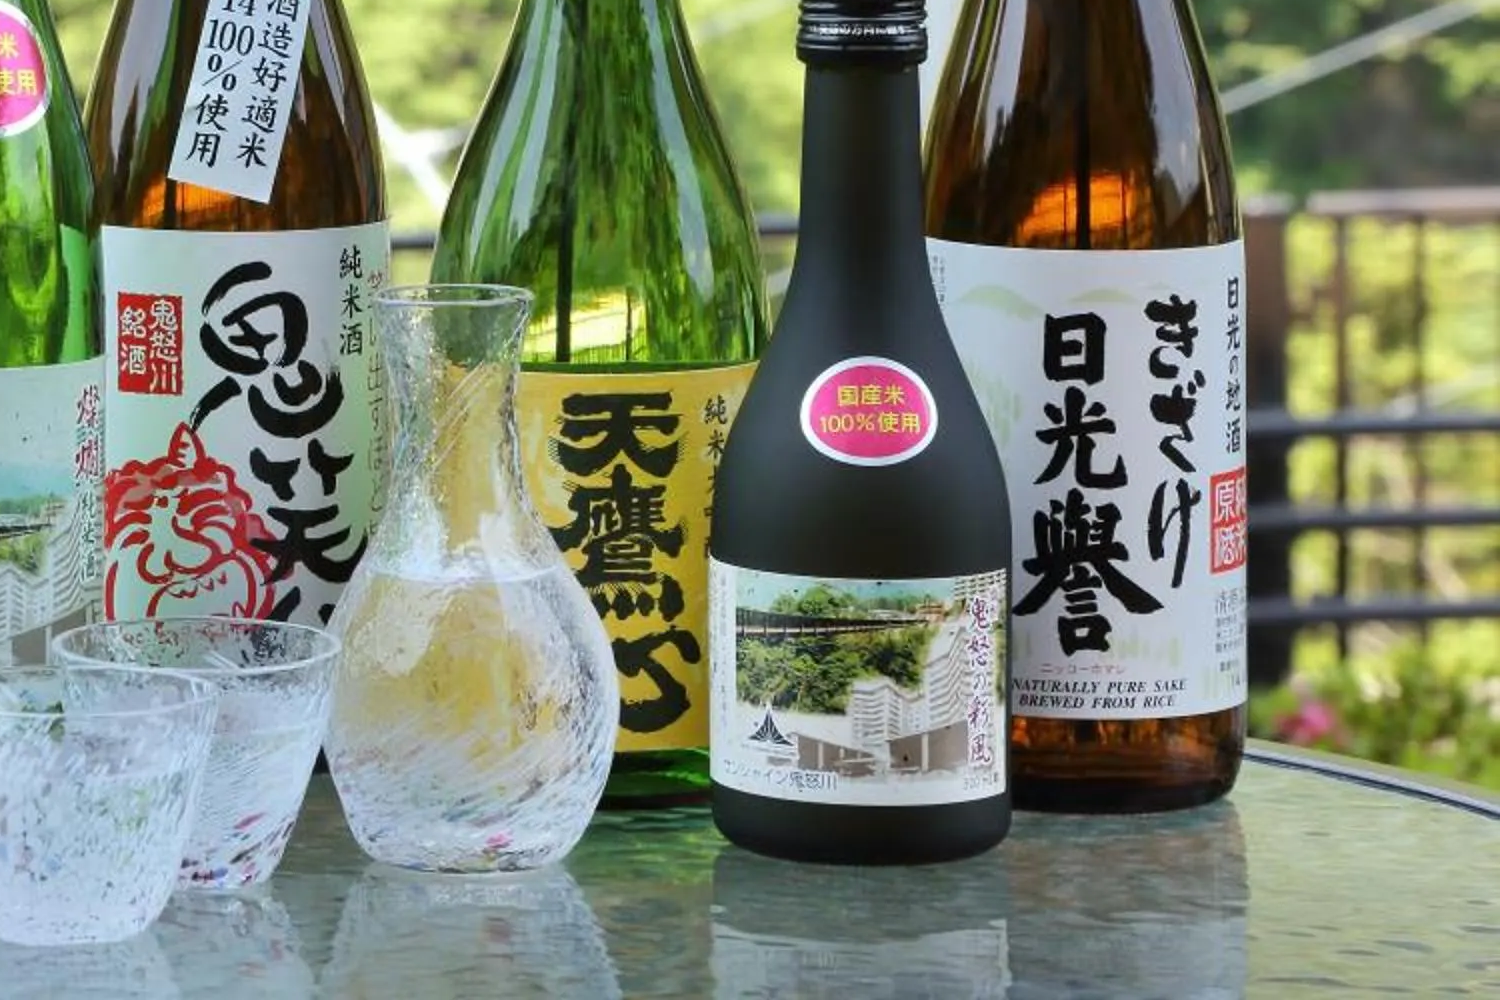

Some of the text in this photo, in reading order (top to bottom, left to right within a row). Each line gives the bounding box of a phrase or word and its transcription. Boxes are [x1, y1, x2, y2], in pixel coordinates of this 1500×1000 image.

[339, 245, 363, 355] 純米酒
[120, 306, 146, 374] 銘酒
[148, 299, 178, 393] 鬼怒川
[838, 384, 905, 407] 国産米
[820, 411, 920, 434] 100%使用
[1144, 294, 1206, 589] きざけ
[1012, 678, 1188, 694] NATURALLY PURE SAKE
[1019, 693, 1175, 710] BREWED FROM RICE
